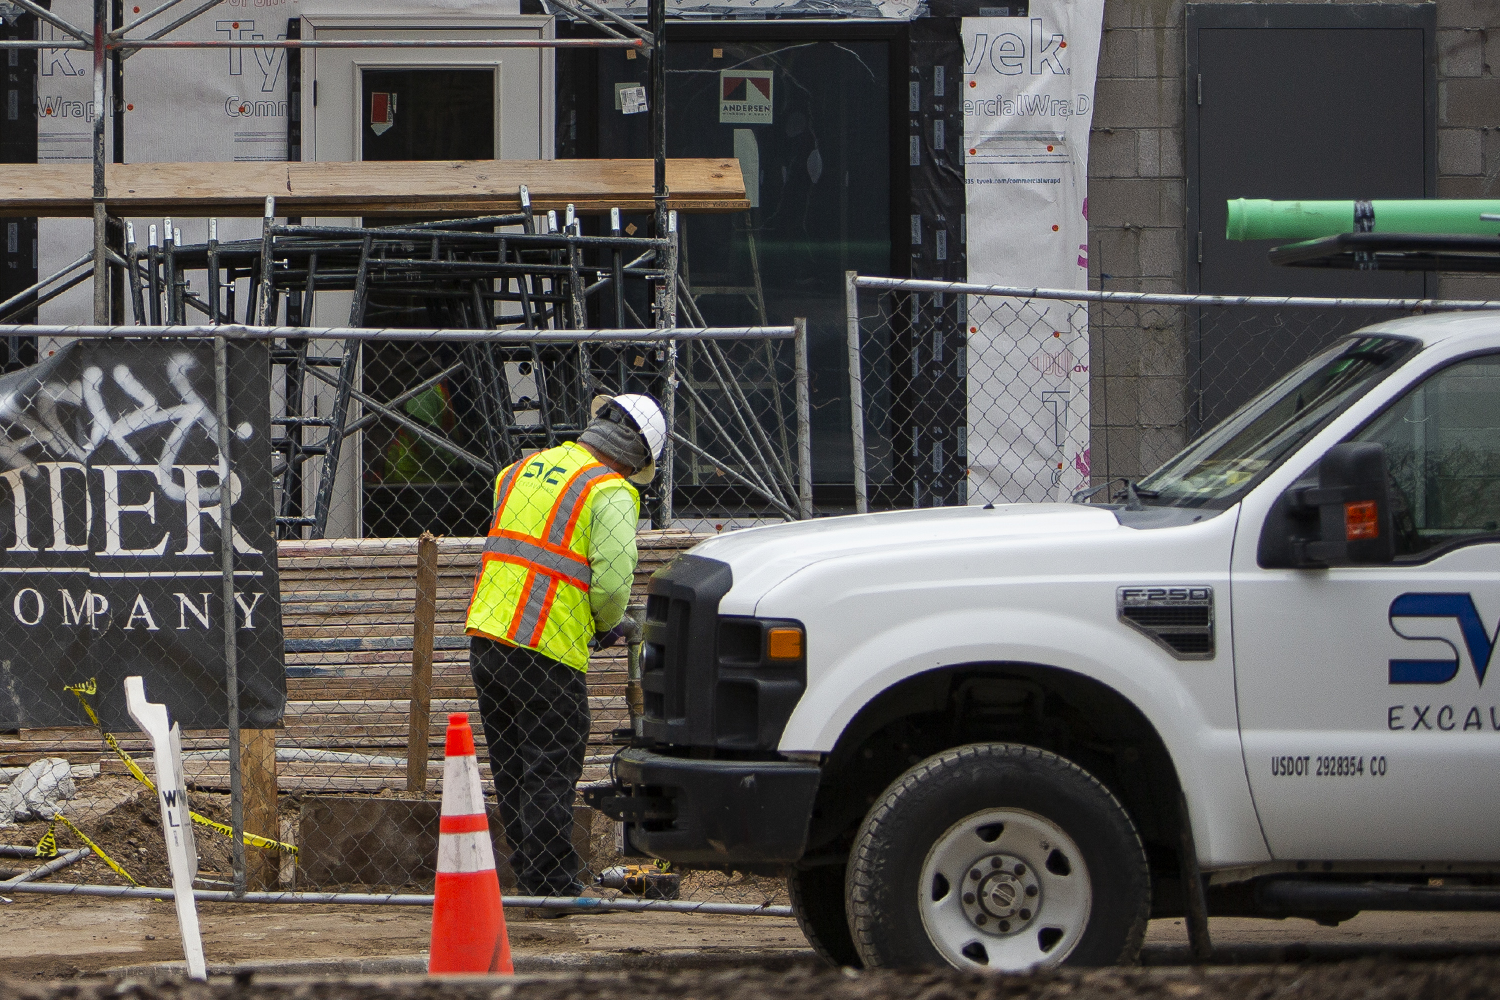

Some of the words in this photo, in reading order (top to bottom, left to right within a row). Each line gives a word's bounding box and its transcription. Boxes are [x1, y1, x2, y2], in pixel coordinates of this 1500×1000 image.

[722, 104, 770, 112] ANDERSEN
[1122, 588, 1208, 601] F-250
[1271, 756, 1311, 777] USDOT
[1315, 756, 1364, 777] 2928354
[1370, 756, 1388, 777] CO
